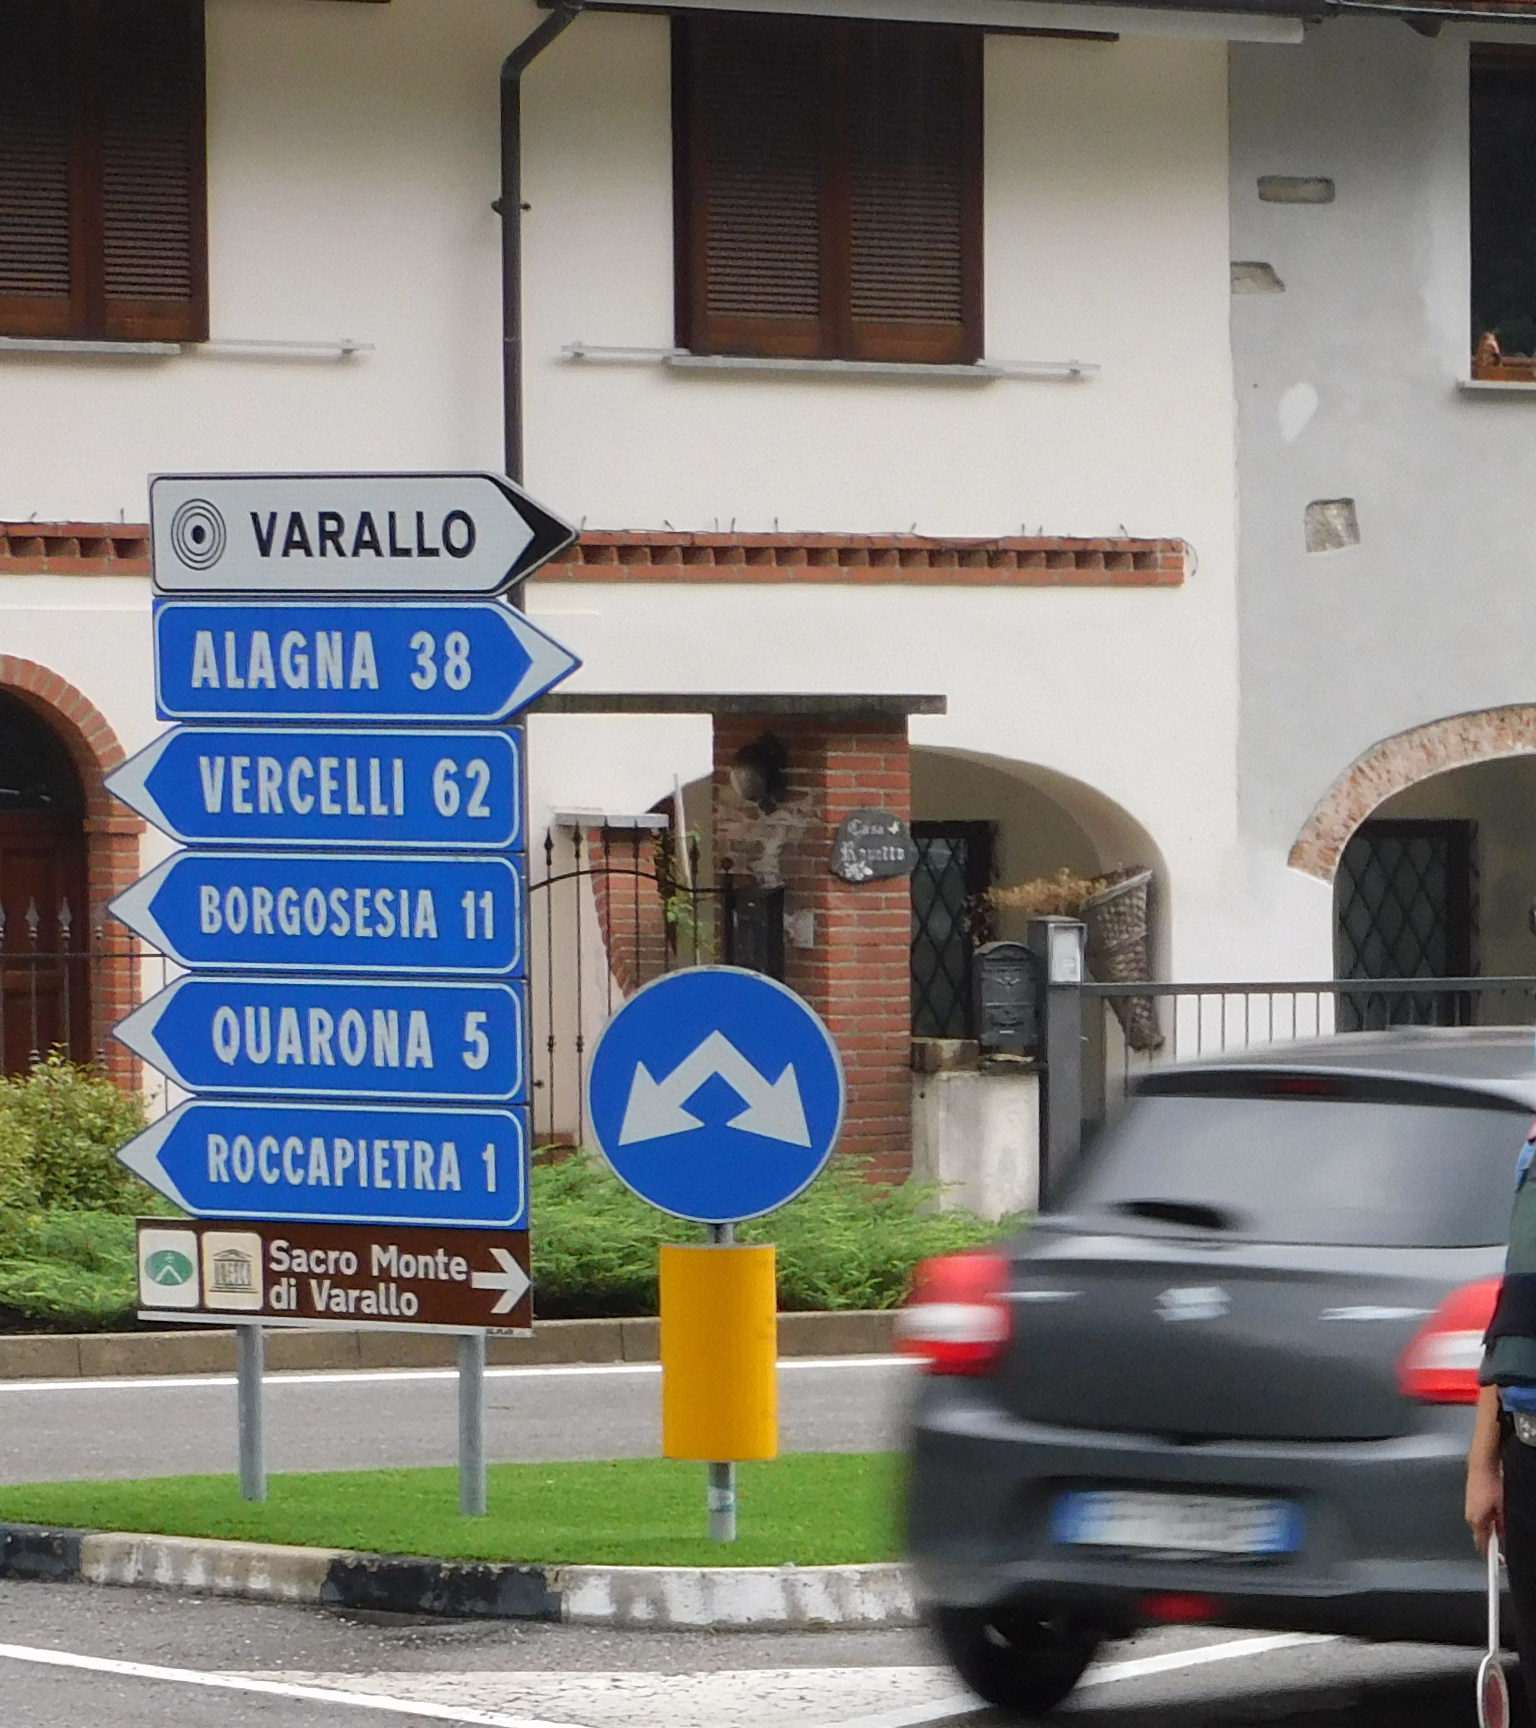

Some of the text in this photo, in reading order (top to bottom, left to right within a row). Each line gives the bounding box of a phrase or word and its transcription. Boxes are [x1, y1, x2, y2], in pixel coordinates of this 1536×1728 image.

[250, 509, 476, 558] VARALLO
[191, 630, 471, 690] ALAGNA 38
[199, 756, 491, 817] VERCELLI 62
[200, 884, 494, 939] BORGOSESIA 11
[213, 1005, 489, 1070] QUARONA 5
[208, 1133, 496, 1192] ROCCAPIETRA 1
[269, 1241, 468, 1281] Sacro Monte
[269, 1279, 418, 1316] di Varallo
